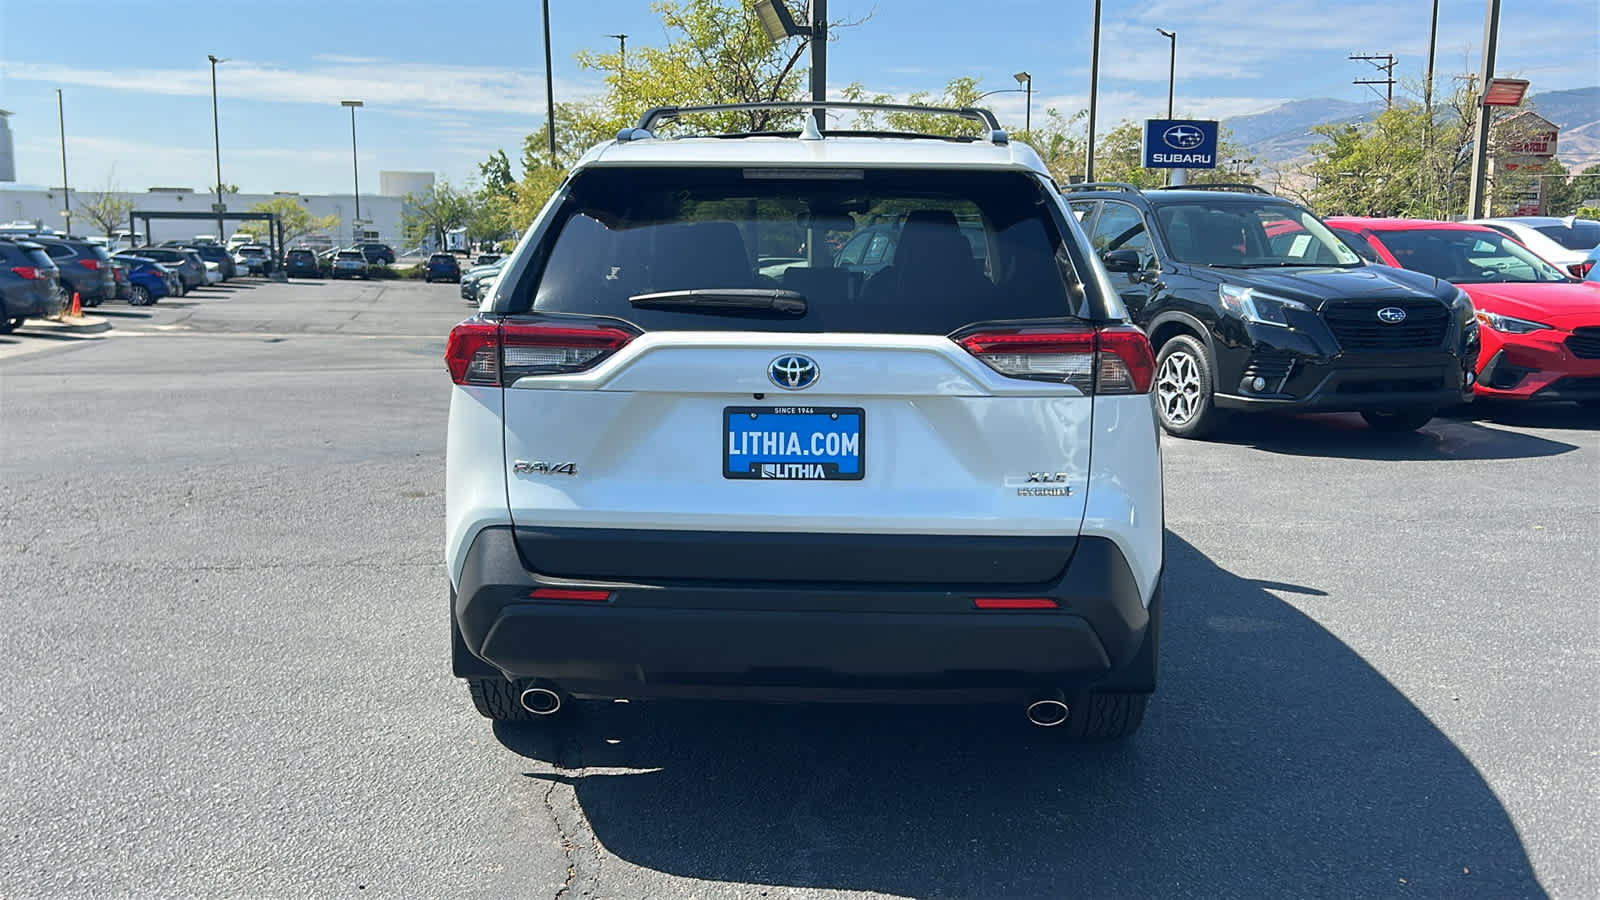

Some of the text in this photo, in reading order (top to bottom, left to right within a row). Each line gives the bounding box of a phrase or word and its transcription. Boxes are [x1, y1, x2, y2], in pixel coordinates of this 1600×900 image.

[1153, 153, 1211, 164] SUBARU
[728, 431, 859, 456] LITHIA.COM
[513, 460, 577, 475] RAV4
[776, 464, 826, 479] LITHIA
[1025, 472, 1068, 483] XLE
[1017, 487, 1067, 497] HYBRID
